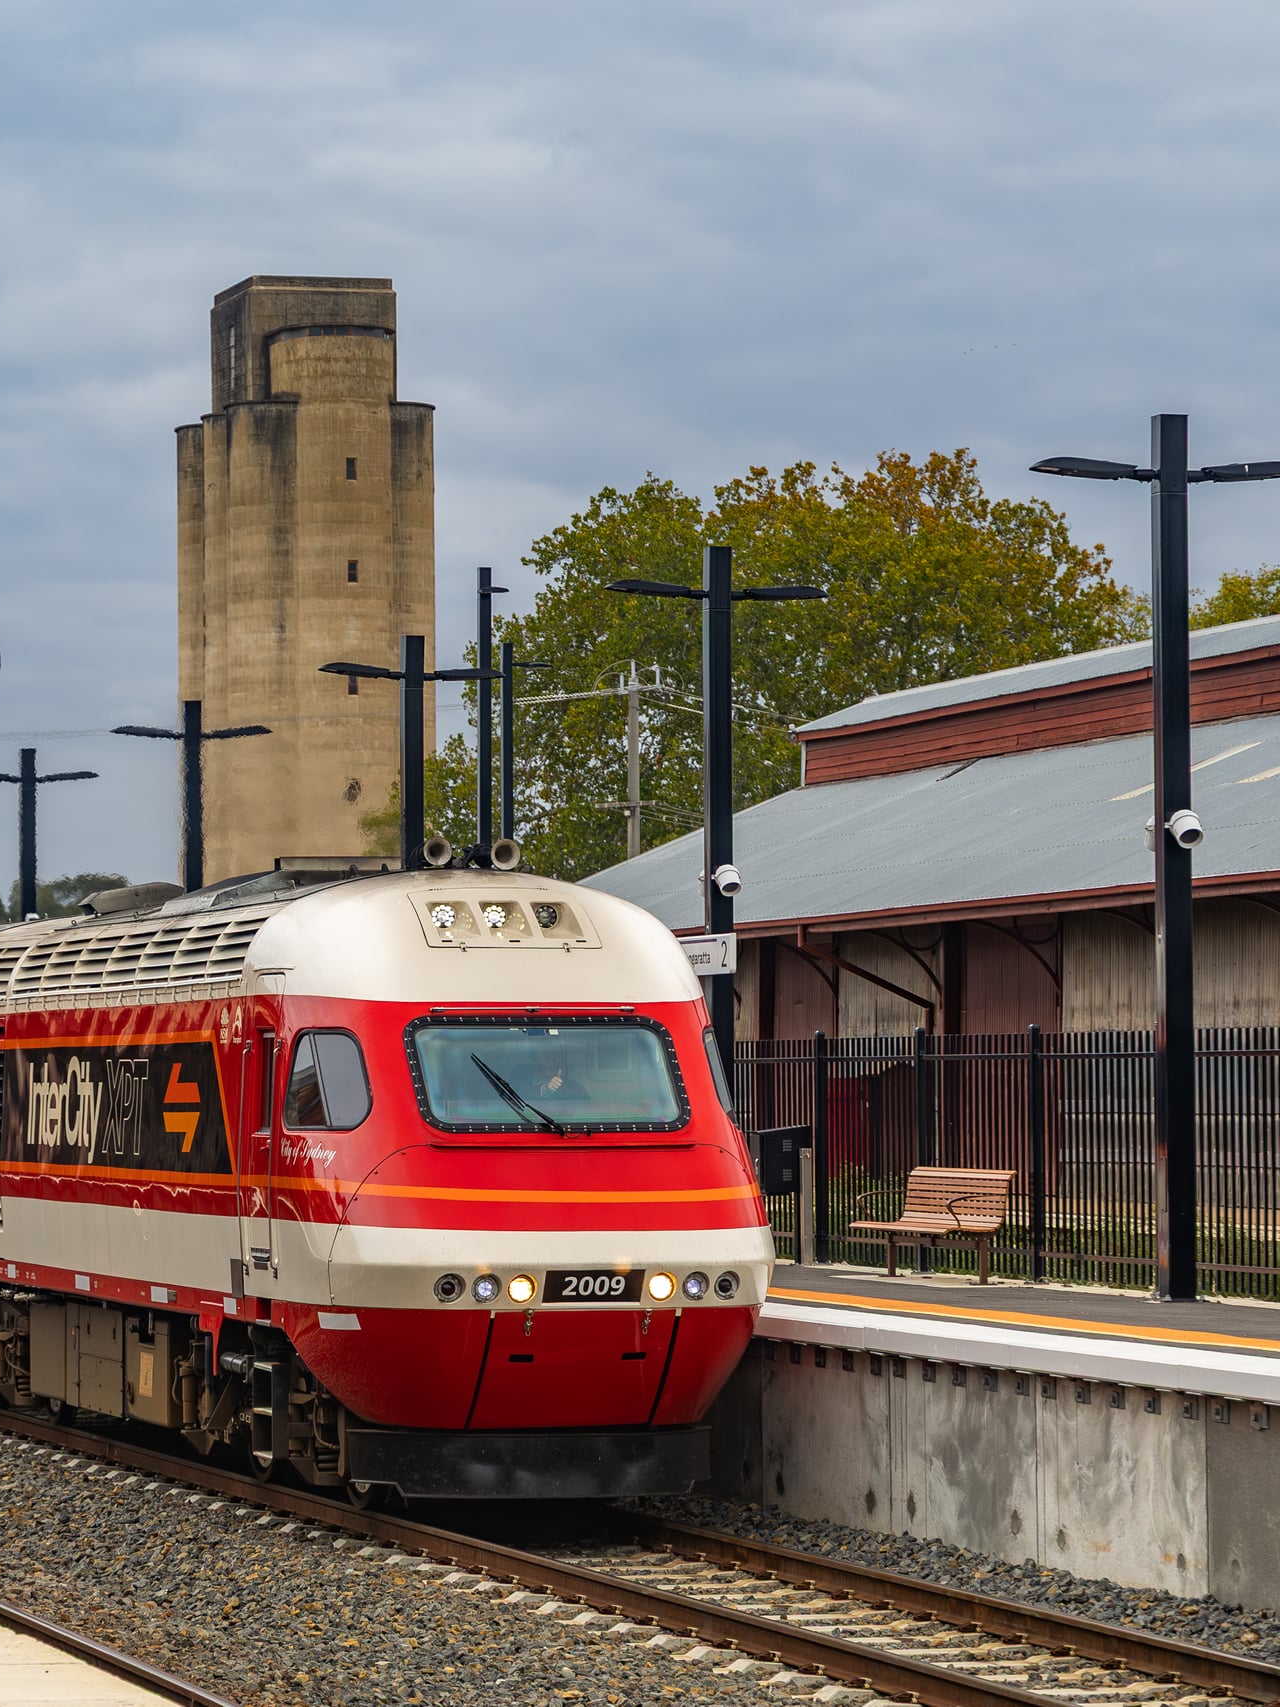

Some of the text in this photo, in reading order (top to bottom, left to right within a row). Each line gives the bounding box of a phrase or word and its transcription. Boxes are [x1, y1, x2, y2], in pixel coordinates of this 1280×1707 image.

[721, 940, 728, 968] 2
[27, 1055, 149, 1164] InterCity XPT
[281, 1137, 337, 1169] City of Sydney
[561, 1275, 626, 1297] 2009
